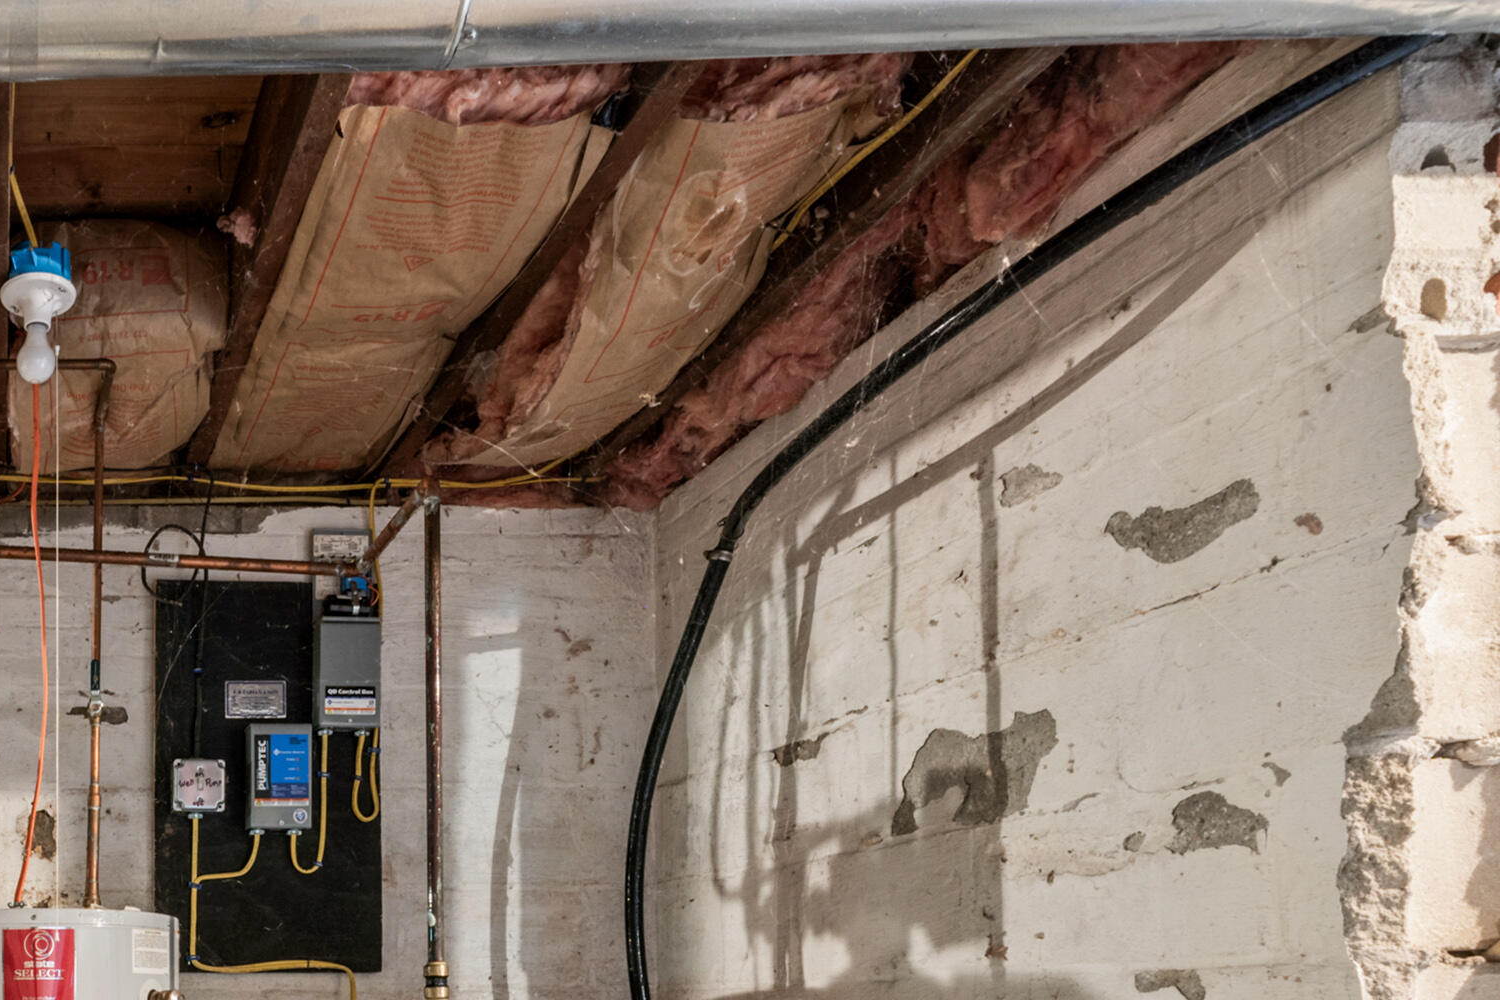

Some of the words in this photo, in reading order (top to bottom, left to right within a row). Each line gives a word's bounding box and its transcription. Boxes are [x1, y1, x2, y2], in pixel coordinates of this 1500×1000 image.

[81, 259, 135, 285] R-19
[257, 740, 267, 790] PUMPTEC
[14, 968, 65, 977] SELECT
